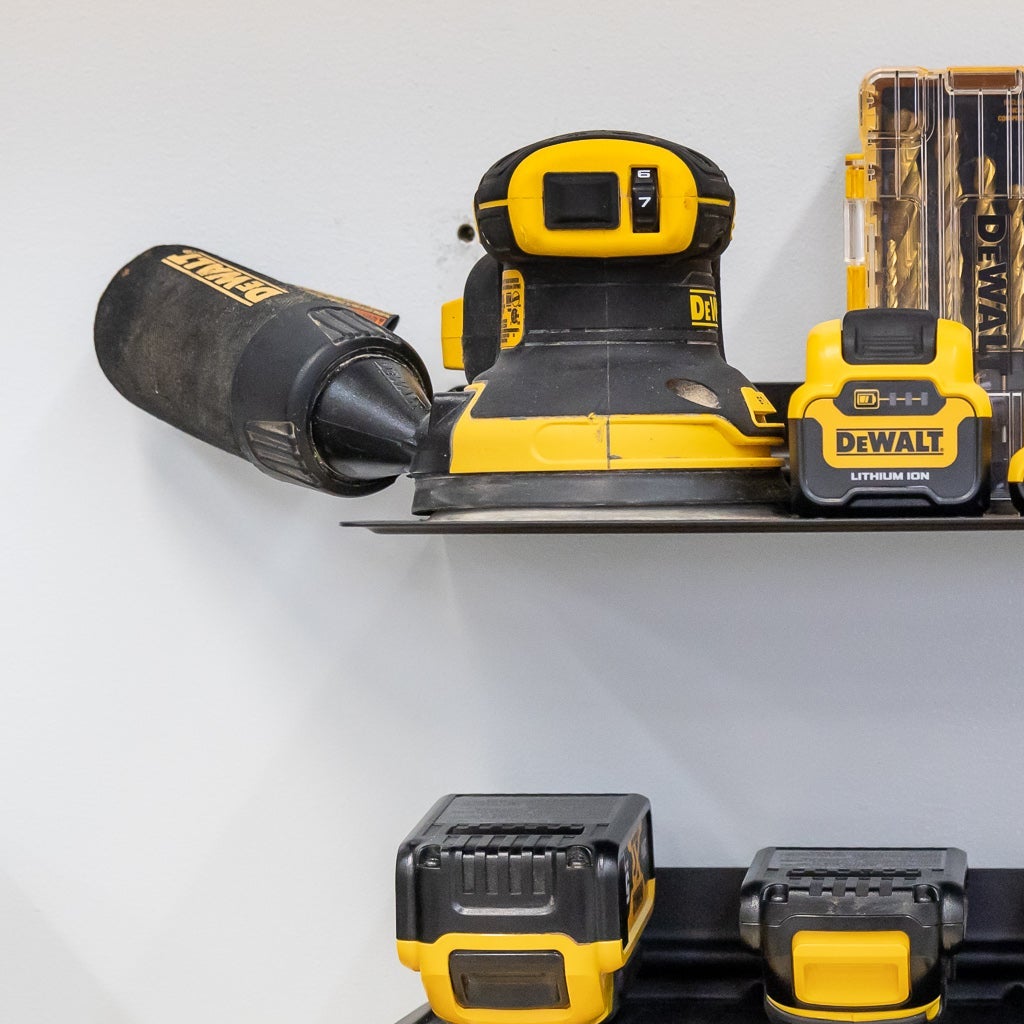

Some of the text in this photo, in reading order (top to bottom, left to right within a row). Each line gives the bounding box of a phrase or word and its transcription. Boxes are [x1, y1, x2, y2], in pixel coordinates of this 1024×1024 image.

[637, 169, 651, 178] 6
[638, 196, 652, 208] 7
[166, 251, 285, 304] DEWALT
[978, 215, 1008, 376] DEWALT
[836, 431, 944, 453] DEWALT
[850, 472, 930, 481] LITHIUM ION
